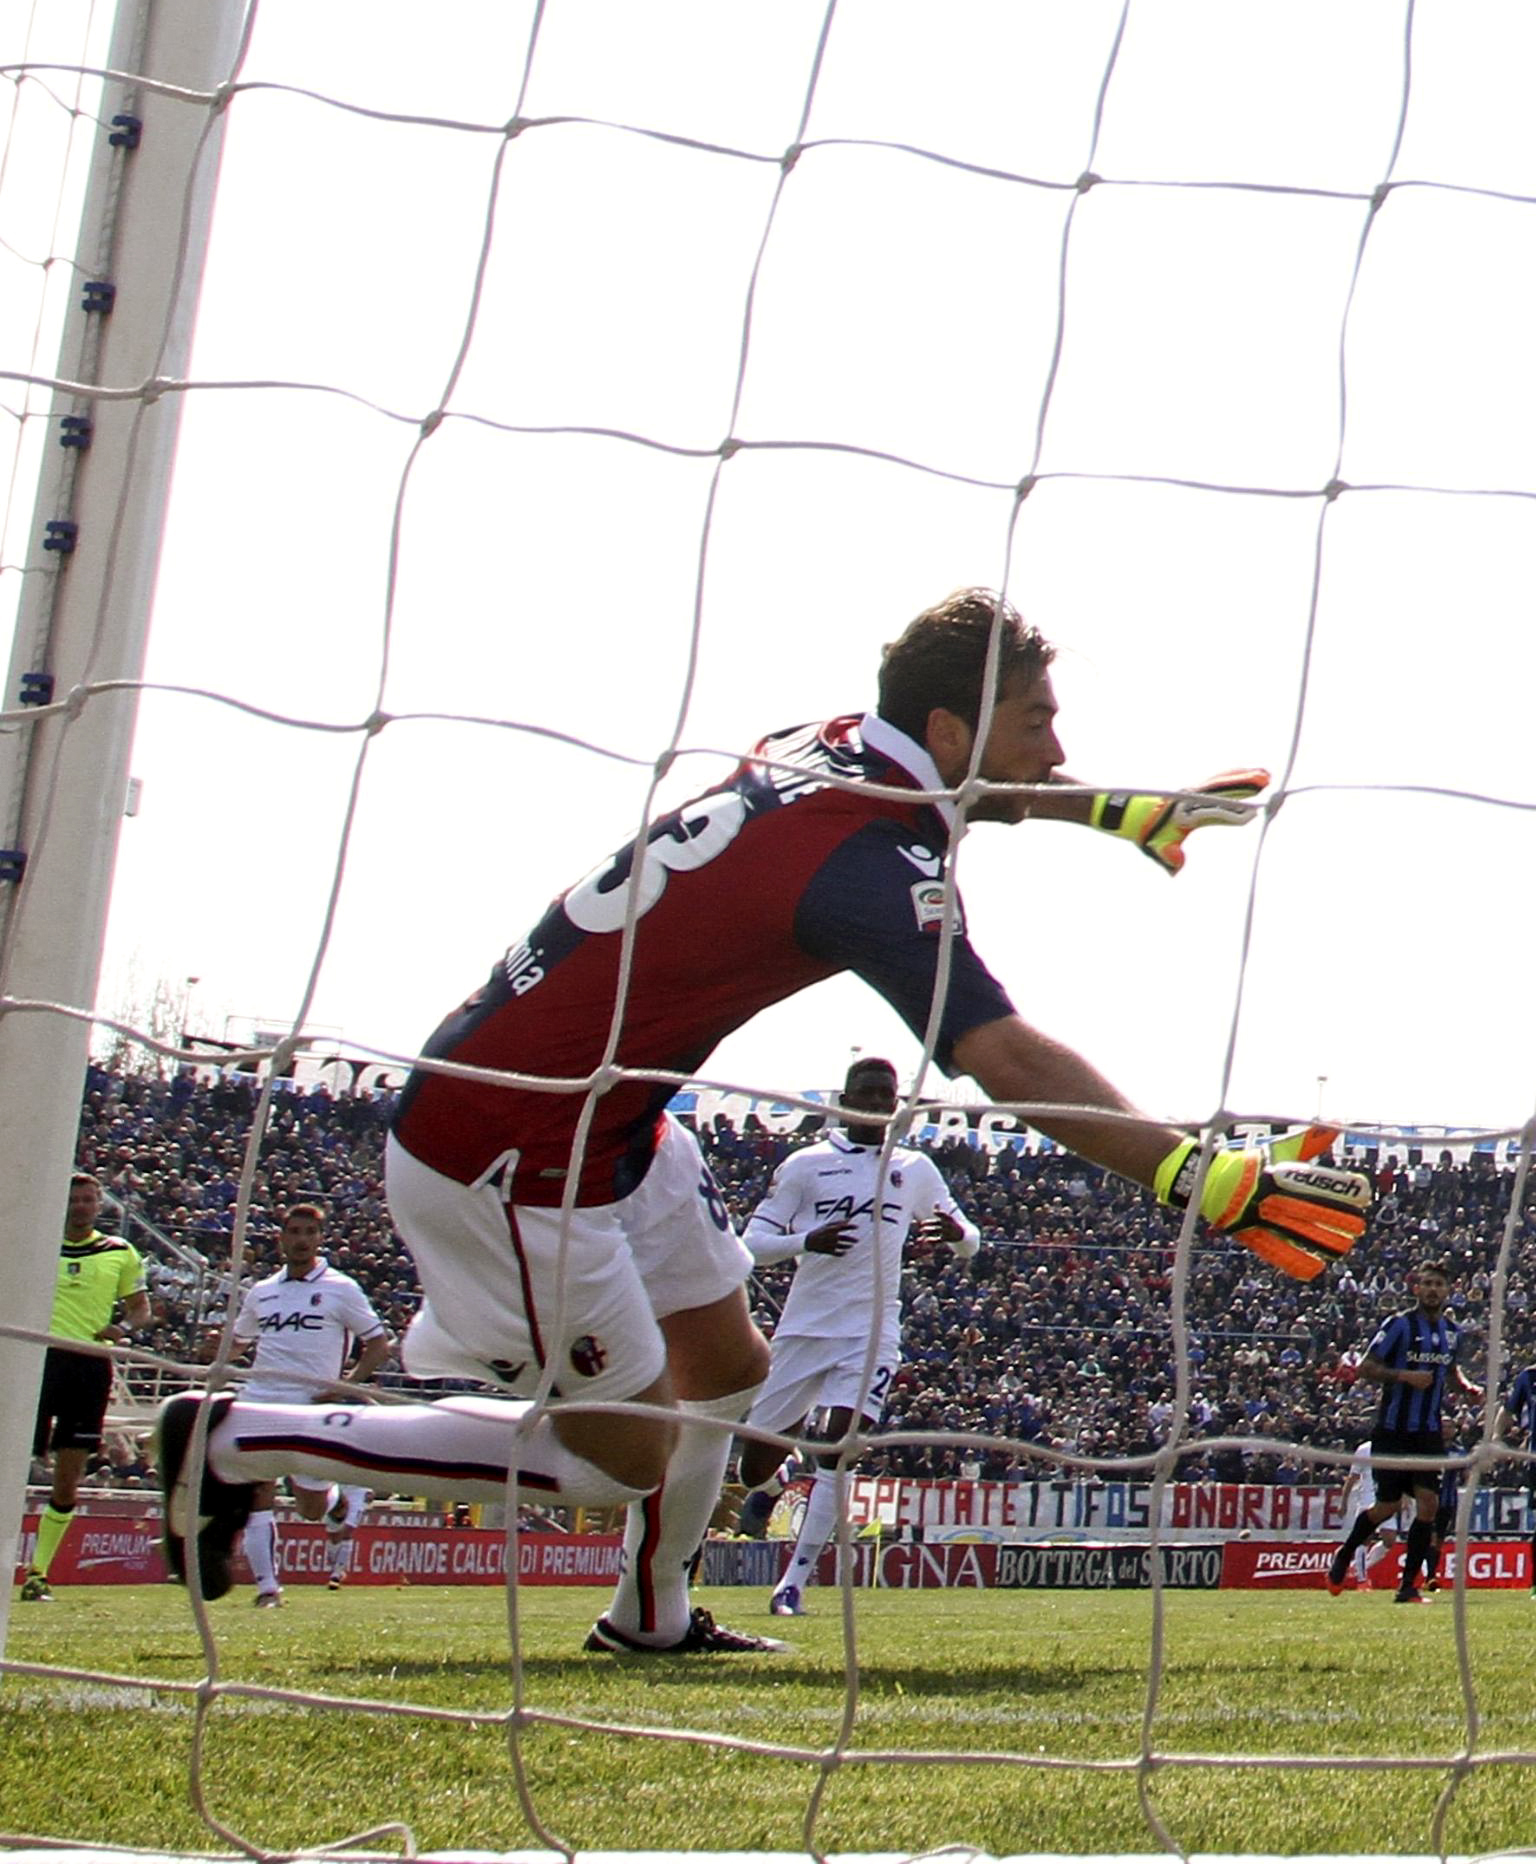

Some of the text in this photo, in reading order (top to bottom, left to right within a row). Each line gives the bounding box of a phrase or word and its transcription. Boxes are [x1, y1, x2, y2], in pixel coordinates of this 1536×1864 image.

[1284, 1168, 1363, 1198] reusch
[814, 1195, 903, 1225] FAAC
[257, 1311, 325, 1333] FAAC
[1050, 1482, 1153, 1529] TIFOS
[81, 1532, 152, 1556] PREMIUM
[274, 1538, 334, 1573] SCEGL
[370, 1540, 449, 1574] GRANDE
[519, 1544, 538, 1574] DI
[542, 1545, 623, 1576] PREMIUM
[1001, 1549, 1220, 1586] BOTTEGA del SARTO
[1256, 1552, 1334, 1570] PREMIU
[1397, 1552, 1525, 1579] SEGLI
